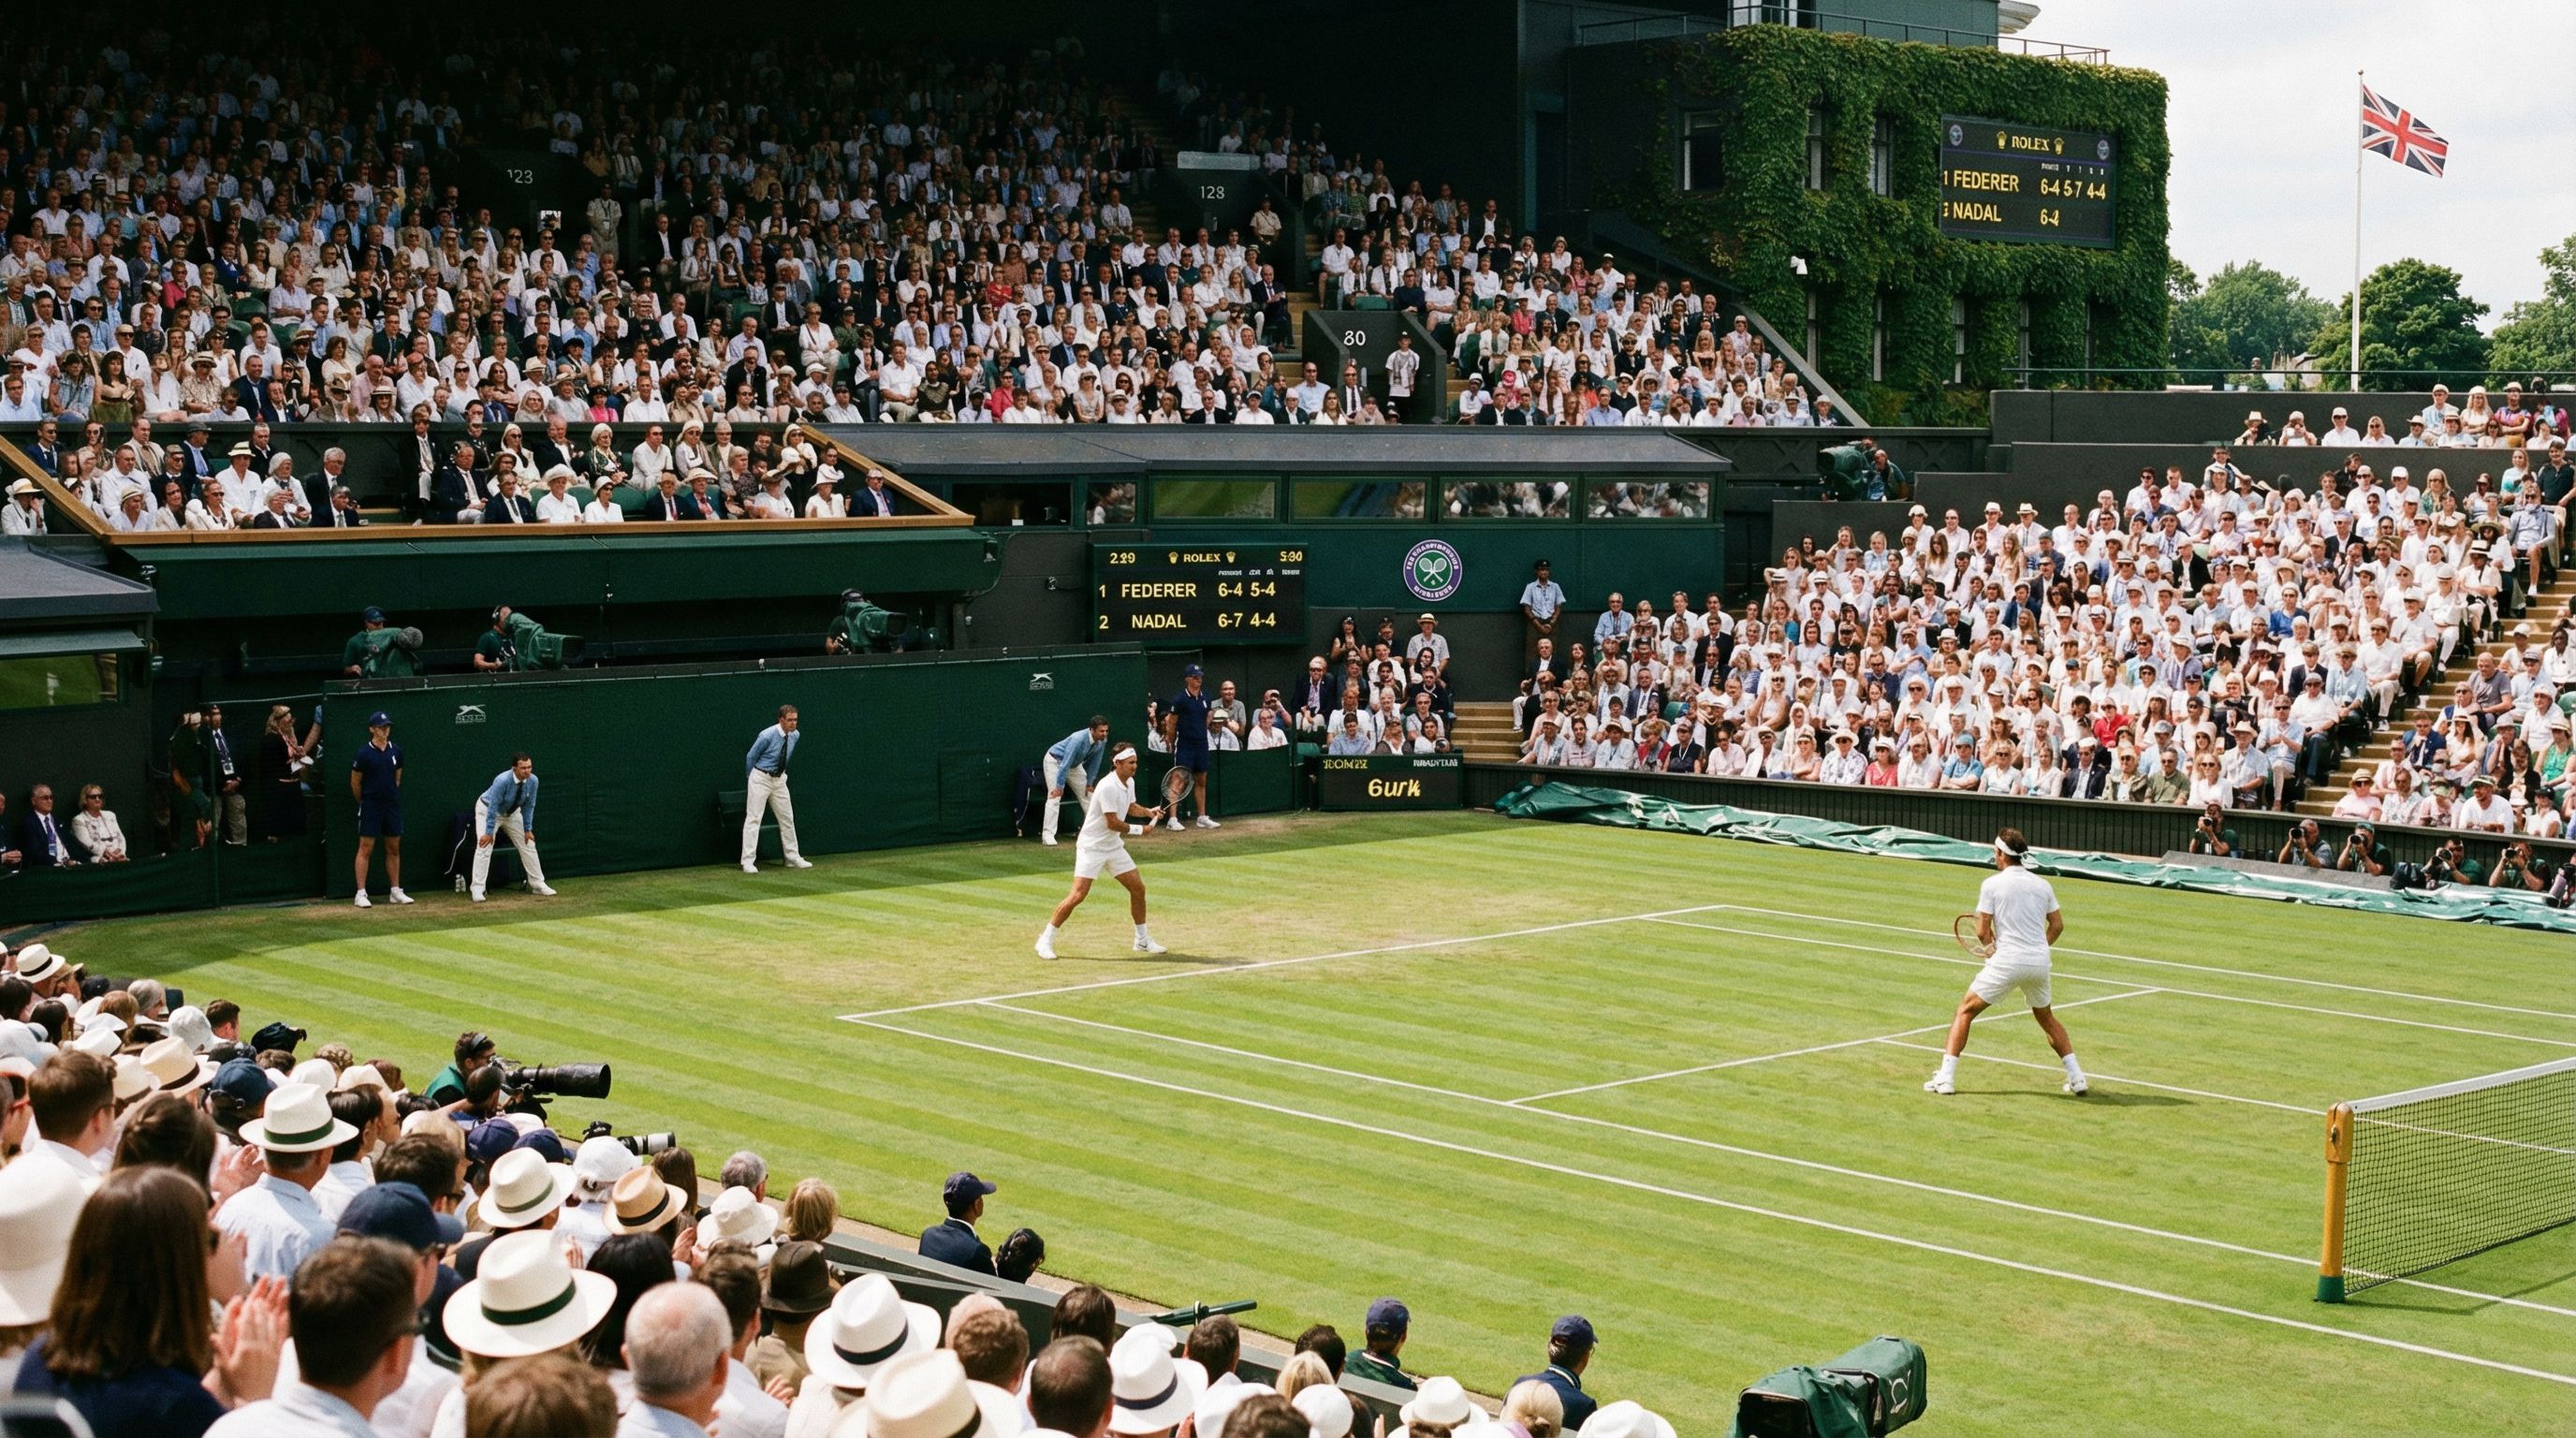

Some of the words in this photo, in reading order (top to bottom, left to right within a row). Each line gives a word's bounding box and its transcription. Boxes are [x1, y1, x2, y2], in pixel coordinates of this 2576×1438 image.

[2012, 136, 2050, 152] ROLEX
[506, 169, 534, 184] 123
[1954, 169, 2019, 193] FEDERER
[1201, 185, 1225, 199] 128
[1953, 201, 2002, 223] NADAL
[1343, 330, 1367, 346] 80
[1183, 553, 1221, 563] ROLEX
[1098, 584, 1106, 598] 1
[1121, 582, 1197, 598] FEDERER
[1218, 581, 1243, 597] 6-4
[1250, 581, 1277, 597] 5-4
[1099, 615, 1109, 629] 2
[1132, 613, 1187, 629] NADAL
[1218, 612, 1244, 628] 6-7
[1250, 612, 1277, 627] 4-4
